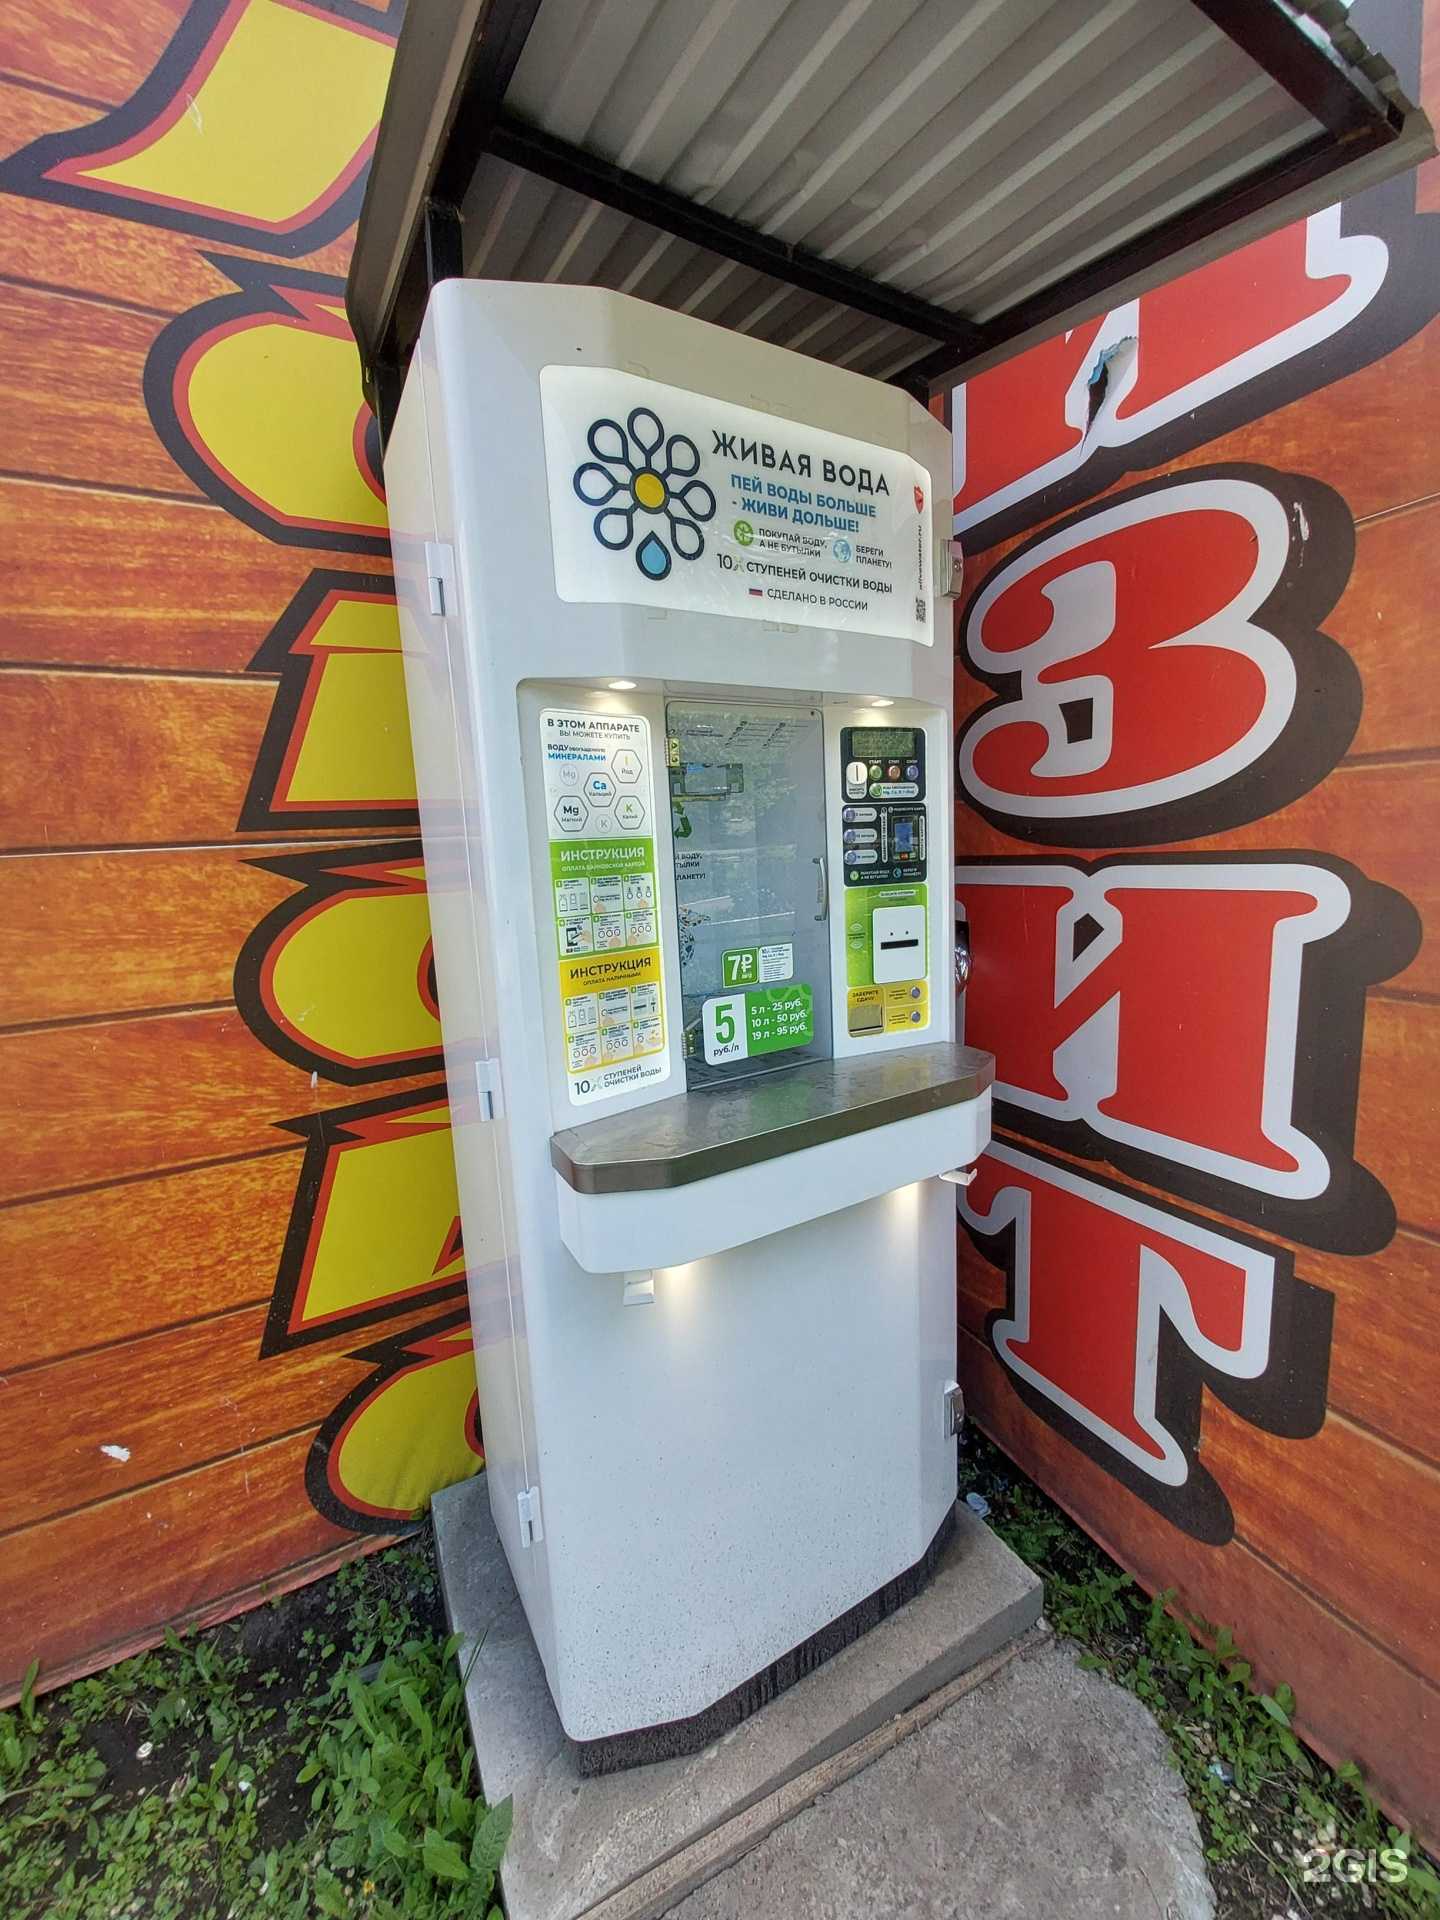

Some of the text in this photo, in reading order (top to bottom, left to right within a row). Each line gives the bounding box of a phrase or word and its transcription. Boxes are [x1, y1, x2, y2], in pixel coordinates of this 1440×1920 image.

[712, 430, 890, 496] ЖИВАЯ ВОДА
[731, 474, 877, 517] ПЕЙ ВОДЫ БОЛЬШЕ
[742, 497, 788, 519] ЖИВИ
[792, 509, 860, 532] ДОЛЬШЕ!
[758, 528, 801, 544] ПОКУПАЙ
[759, 540, 821, 558] А НЕ БУТЫЛКИ
[856, 545, 884, 557] БЕРЕГИ
[746, 561, 806, 581] СТУПЕНЕЙ
[809, 571, 860, 588] ОЧИСТКИ
[862, 580, 893, 593] ВОДЫ
[767, 588, 868, 611] СДЕЛАНО В РОССИИ
[547, 718, 640, 733] В ЭТОМ АППАРАТЕ
[548, 753, 606, 761] МИНЕРАЛАМИ
[593, 780, 607, 790] Ca
[563, 805, 579, 816] Mg
[560, 847, 645, 862] ИНСТРУКЦИЯ
[570, 957, 651, 979] ИНСТРУКЦИЯ
[751, 1006, 757, 1015] 5
[772, 1001, 783, 1011] 25
[785, 998, 802, 1010] руб.
[715, 1004, 736, 1045] 5
[752, 1019, 761, 1028] 10
[777, 1014, 788, 1023] 50
[790, 1010, 807, 1022] руб.
[752, 1032, 761, 1040] 19
[777, 1026, 788, 1035] 95
[789, 1022, 807, 1034] руб.
[713, 1042, 739, 1057] руб./л
[603, 1064, 642, 1080] СТУПЕНЕЙ
[604, 1067, 662, 1088] ОЧИСТКИ ВОДЫ
